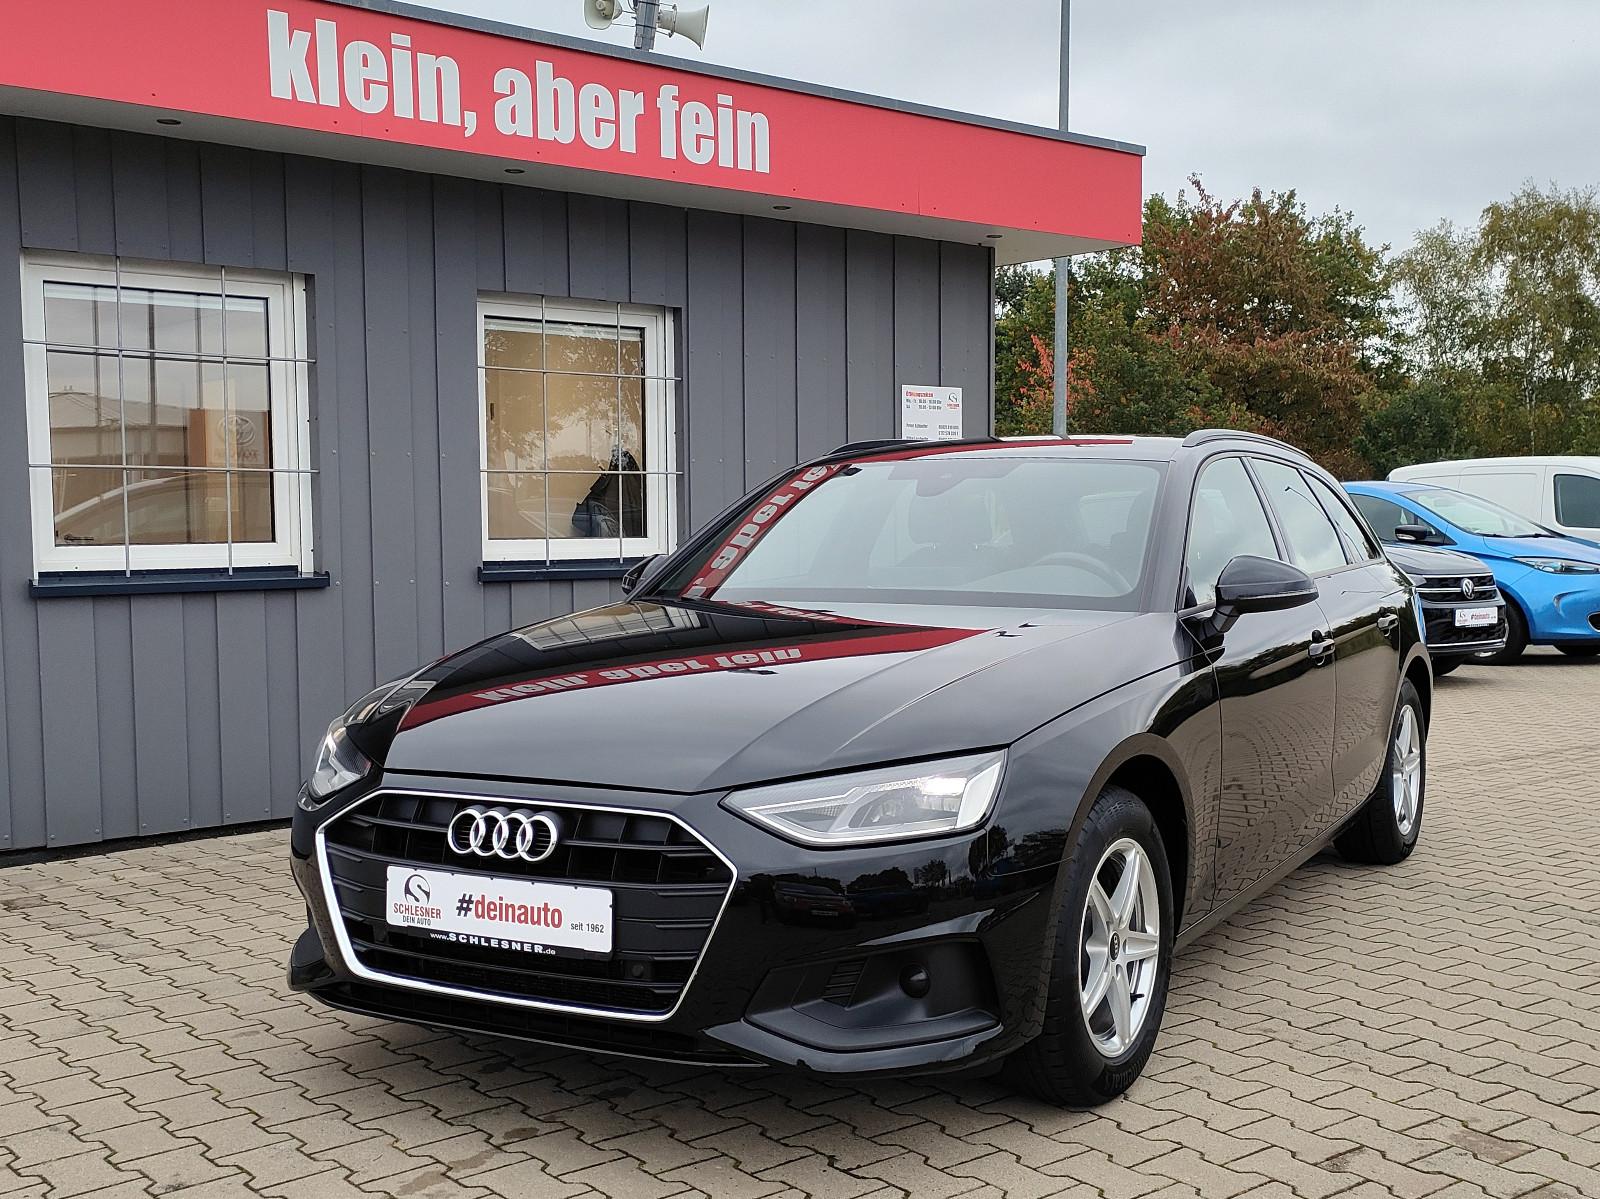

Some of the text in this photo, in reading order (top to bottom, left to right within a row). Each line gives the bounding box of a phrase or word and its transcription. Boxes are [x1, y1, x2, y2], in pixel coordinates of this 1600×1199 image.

[267, 9, 770, 174] klein, aber fein
[393, 902, 442, 919] SCHLESNER
[402, 915, 432, 926] DEIN AUTO
[456, 893, 563, 929] #deinauto
[570, 921, 605, 934] seit 1962
[430, 932, 556, 956] www.SCHLESNER.de
